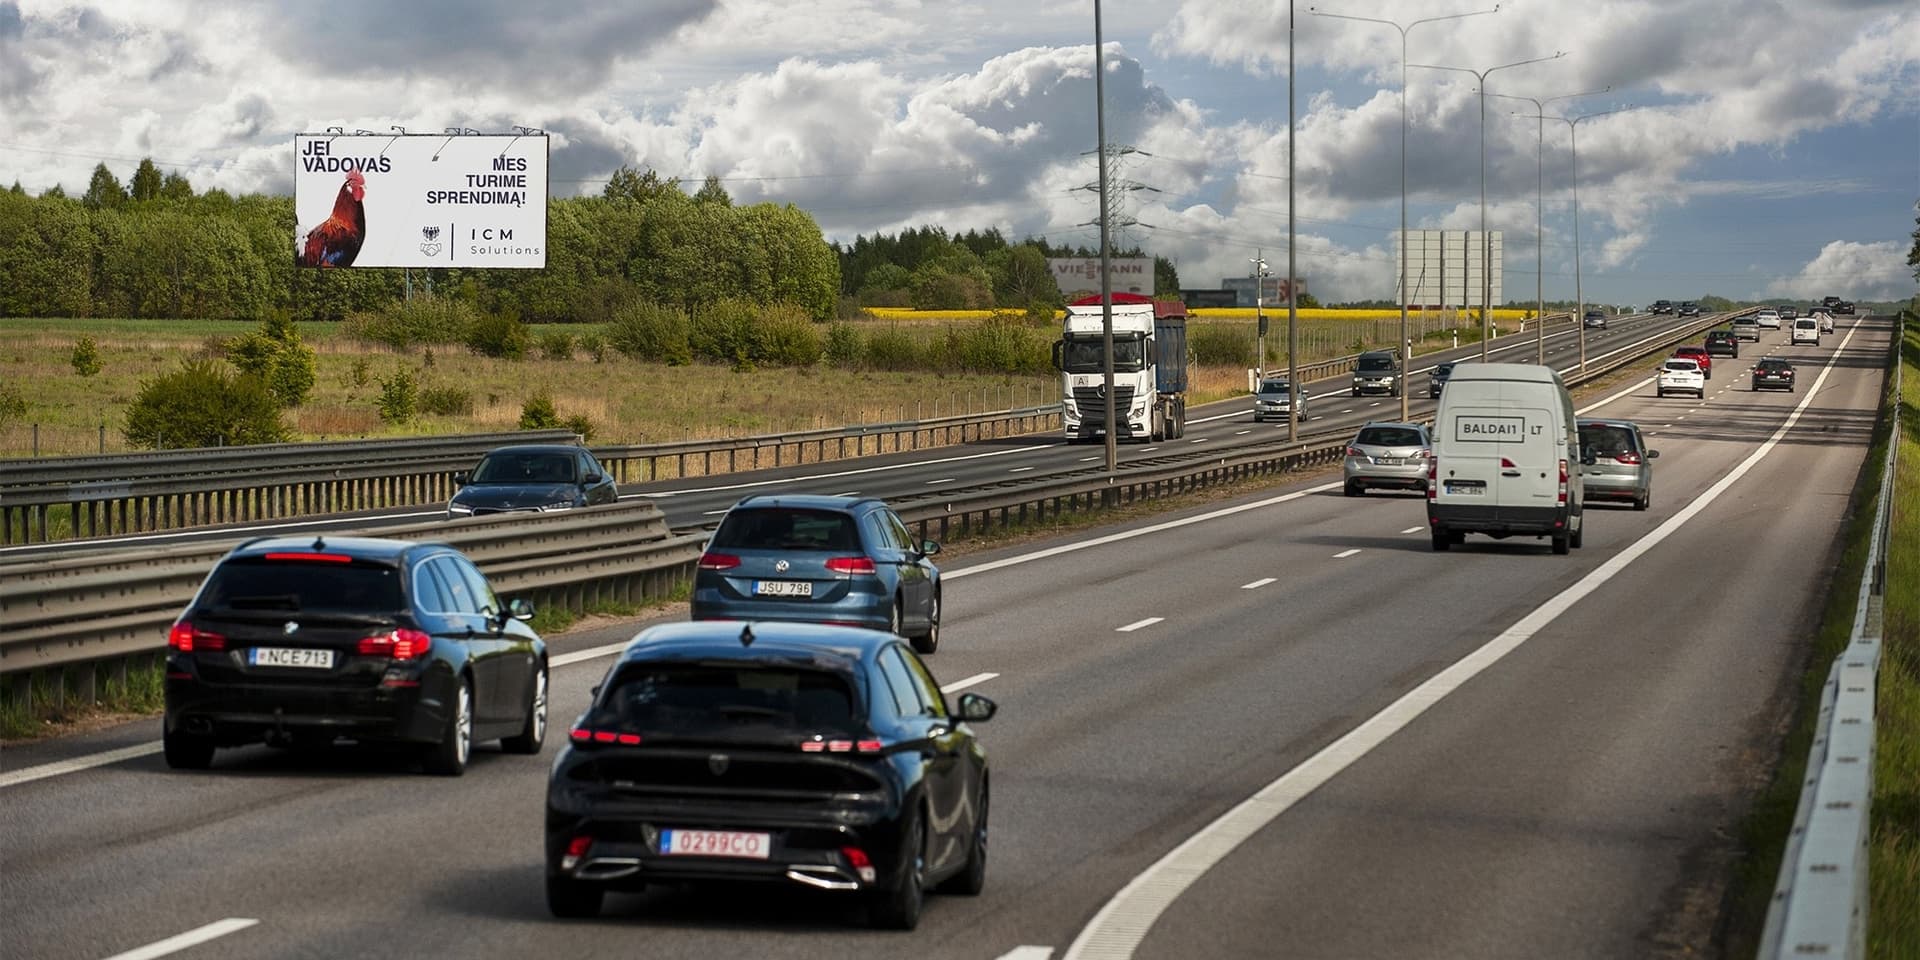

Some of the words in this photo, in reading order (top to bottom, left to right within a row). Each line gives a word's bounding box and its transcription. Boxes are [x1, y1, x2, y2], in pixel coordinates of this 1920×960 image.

[302, 140, 330, 156] JEI
[302, 157, 391, 173] VADOVAS
[493, 158, 527, 171] MES
[466, 174, 526, 188] TURIME
[426, 191, 526, 208] SPRENDIMĄ!
[471, 245, 540, 255] Solutions
[1463, 423, 1517, 434] BALDAI1
[1530, 425, 1543, 435] LT
[759, 582, 783, 593] JSU
[789, 583, 810, 593] 796
